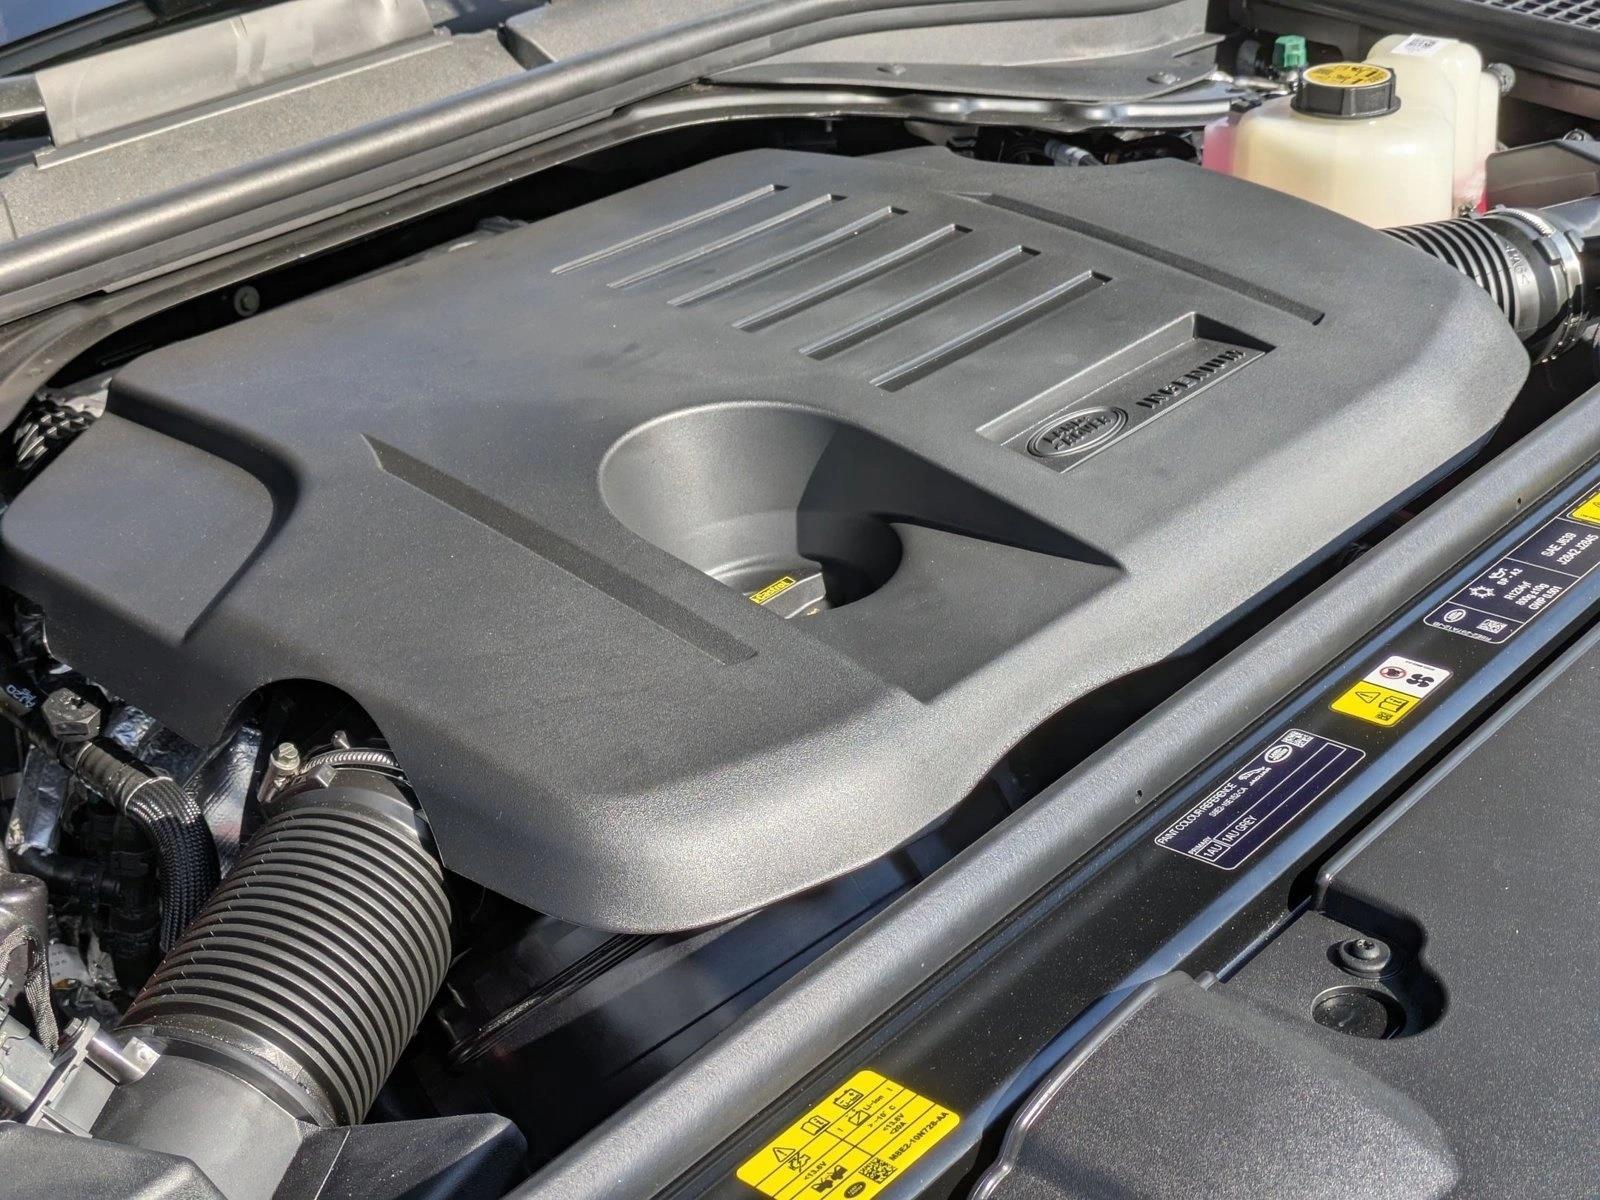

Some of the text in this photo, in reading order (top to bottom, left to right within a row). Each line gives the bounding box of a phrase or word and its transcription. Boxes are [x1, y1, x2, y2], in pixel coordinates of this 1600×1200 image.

[1136, 348, 1247, 409] INGENIUM
[1540, 544, 1562, 557] SAE
[755, 580, 790, 602] Castrol
[1528, 597, 1547, 610] GWP
[1157, 782, 1237, 844] PAINT COLOUR REFERENCE
[1222, 814, 1257, 843] 1AU GREY
[1187, 836, 1212, 855] PRIMARY
[1203, 843, 1223, 858] 1AU
